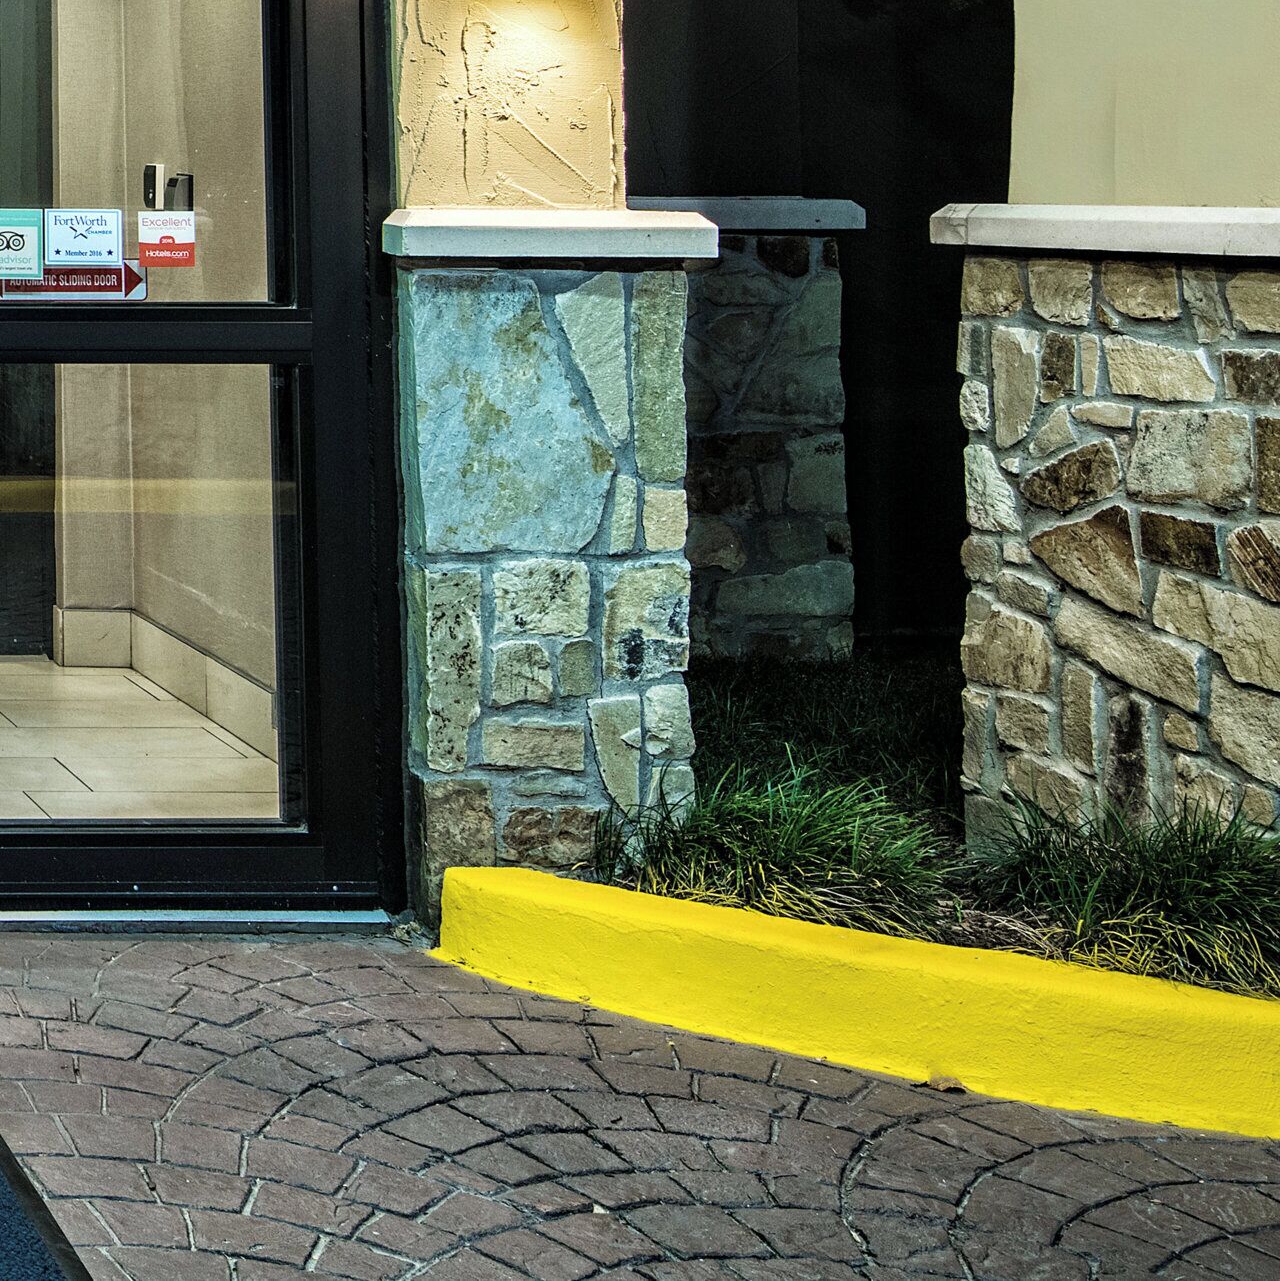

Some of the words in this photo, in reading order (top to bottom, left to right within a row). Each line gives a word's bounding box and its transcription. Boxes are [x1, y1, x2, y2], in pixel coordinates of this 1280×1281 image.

[142, 217, 192, 227] Excellent
[65, 249, 88, 257] Member
[89, 249, 102, 257] 2016
[145, 250, 189, 258] Hotels.com
[59, 275, 92, 286] SLIDING
[94, 275, 118, 286] DOOR
